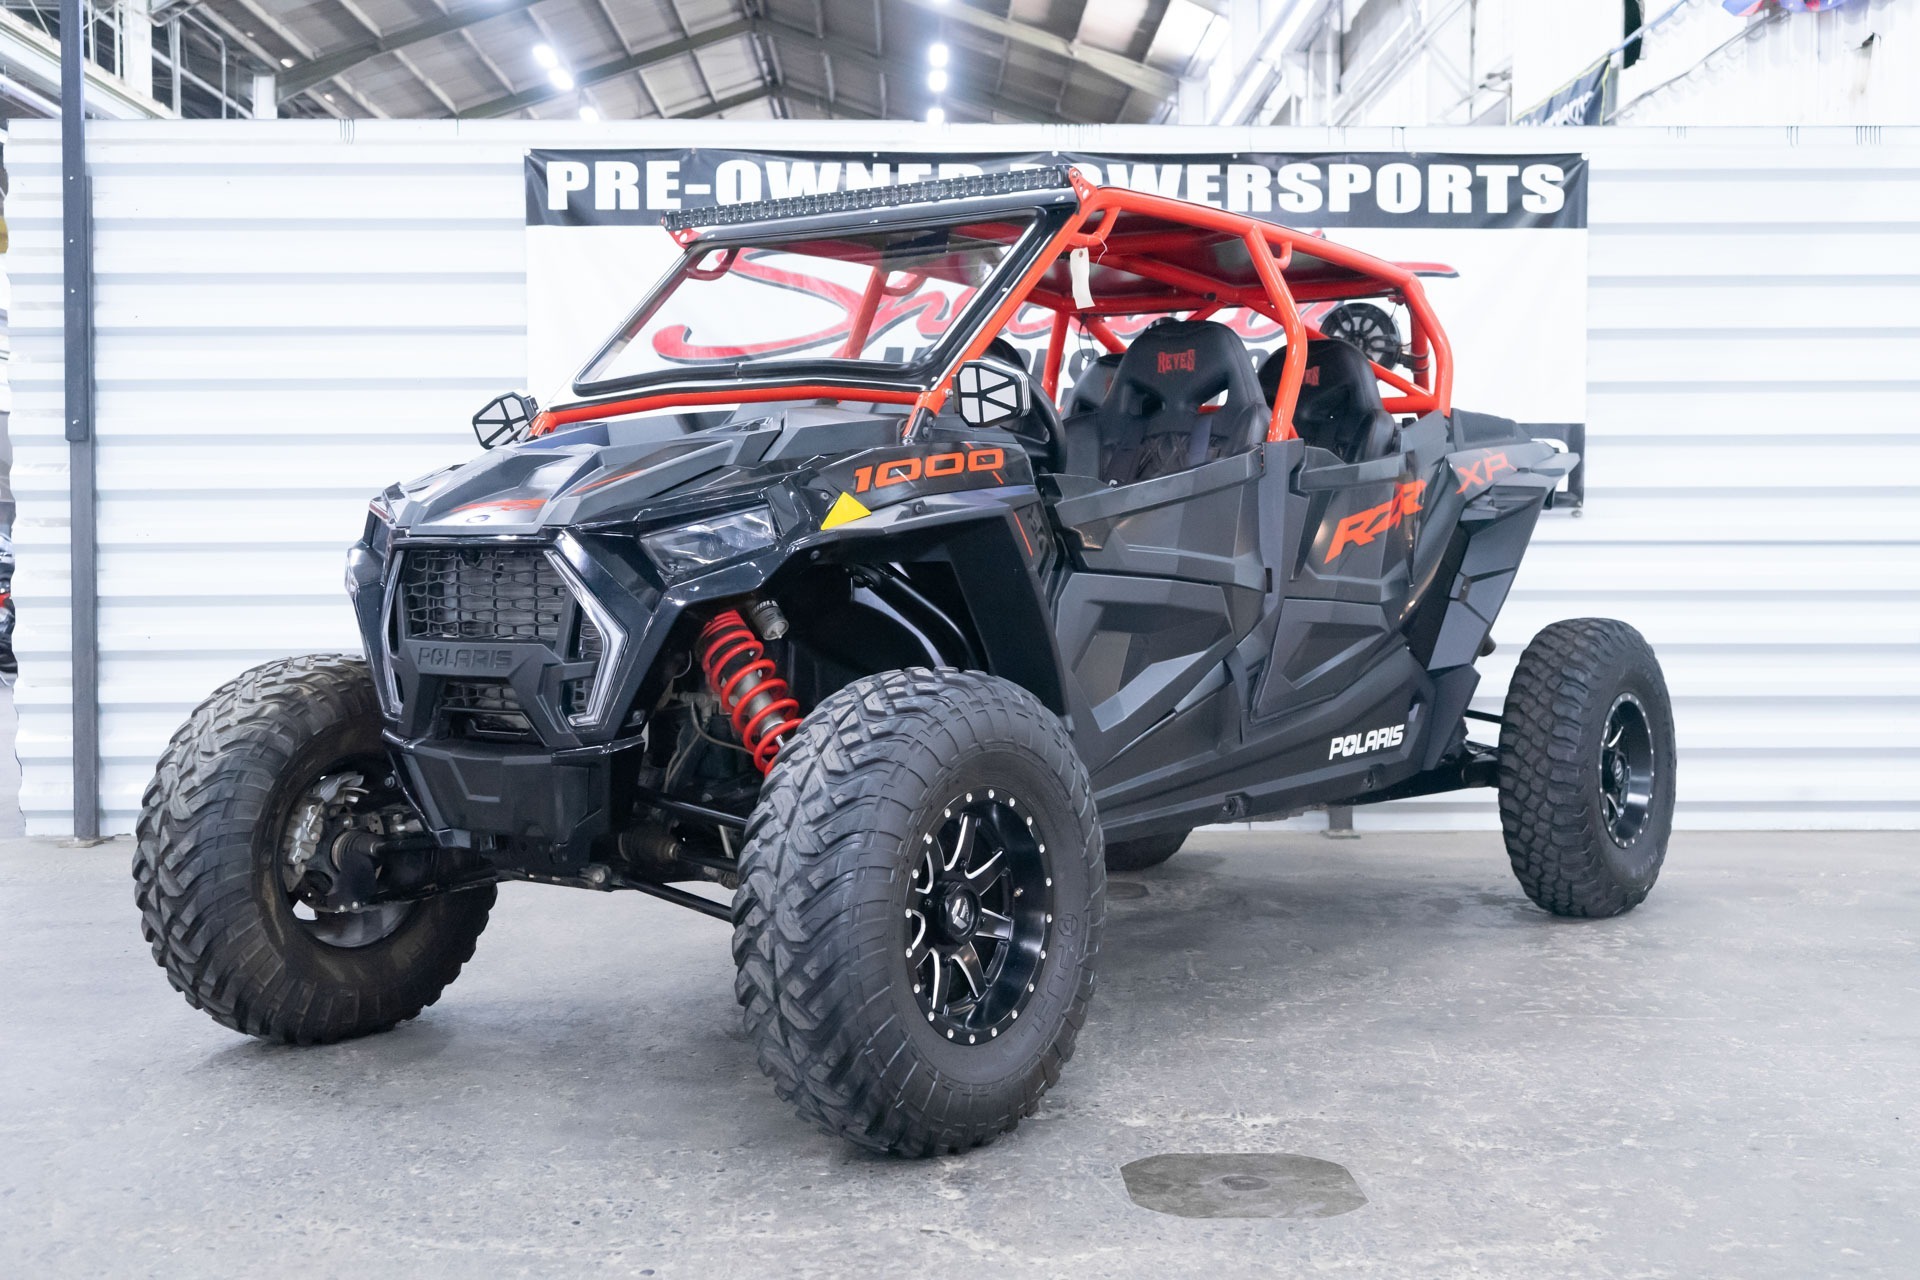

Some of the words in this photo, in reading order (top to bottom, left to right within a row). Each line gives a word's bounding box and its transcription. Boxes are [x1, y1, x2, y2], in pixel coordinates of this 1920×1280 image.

[1010, 162, 1567, 214] WERSPORTS
[854, 448, 1004, 493] 1000
[1456, 451, 1509, 494] XP
[1324, 479, 1427, 564] RZR
[417, 647, 513, 669] POLARIS
[1329, 724, 1405, 760] POLARIS
